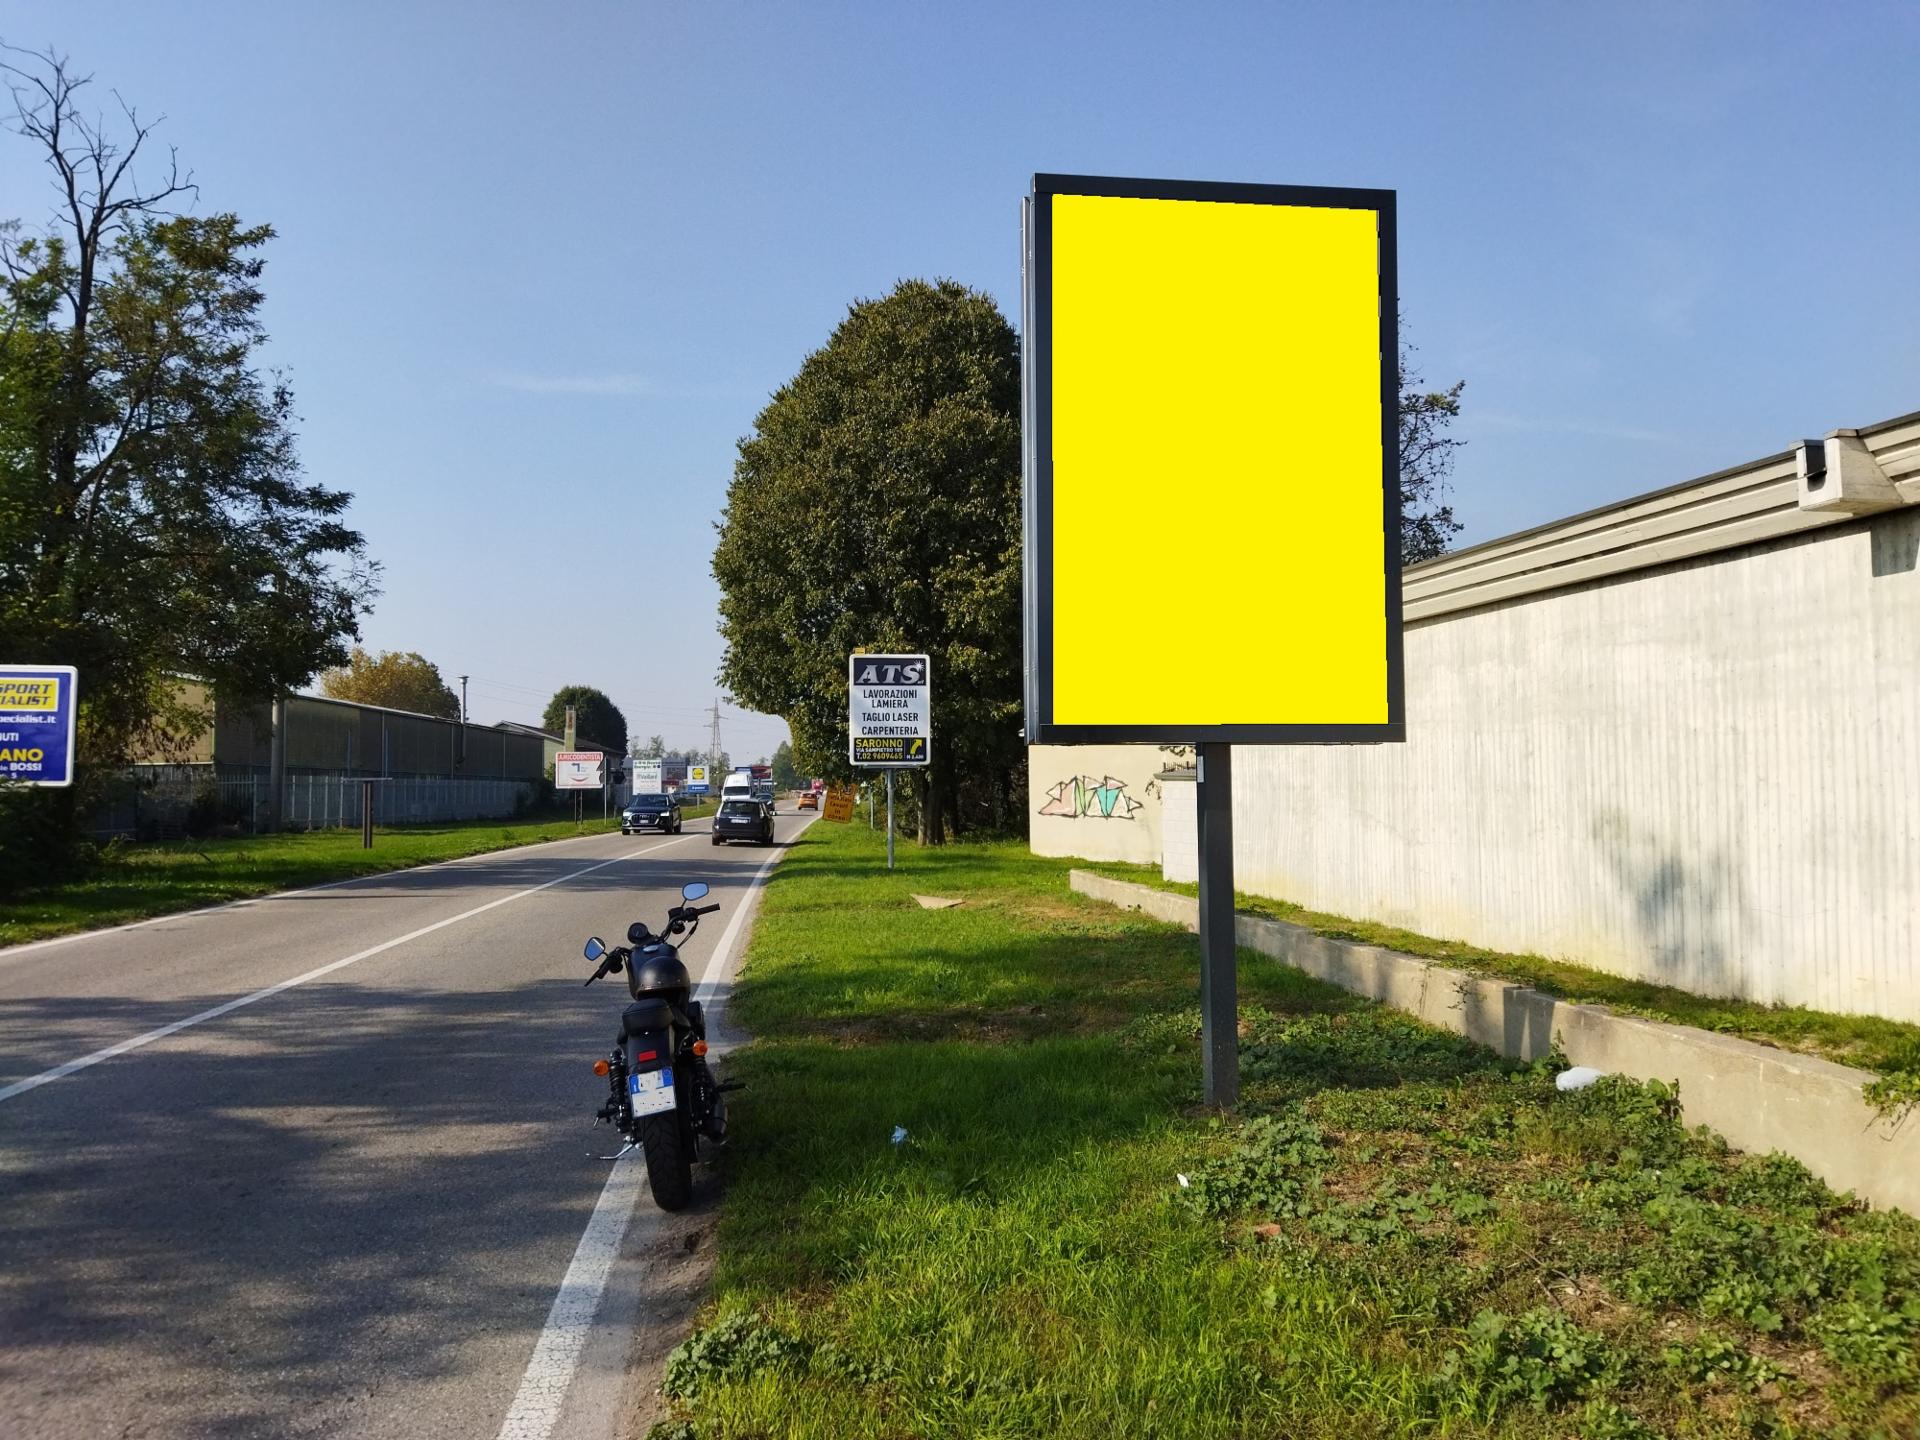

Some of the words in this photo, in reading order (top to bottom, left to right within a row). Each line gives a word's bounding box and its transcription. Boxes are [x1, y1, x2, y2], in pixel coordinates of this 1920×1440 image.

[856, 665, 920, 685] ATS
[863, 689, 917, 699] LAVORAZIONI
[0, 696, 51, 706] IALIST
[872, 700, 908, 709] LAMIERA
[862, 713, 890, 722] TAGLIO
[892, 713, 919, 722] LASER
[862, 727, 919, 736] CARPENTERIA
[856, 738, 903, 748] SARONNO
[10, 762, 42, 771] BOSSI
